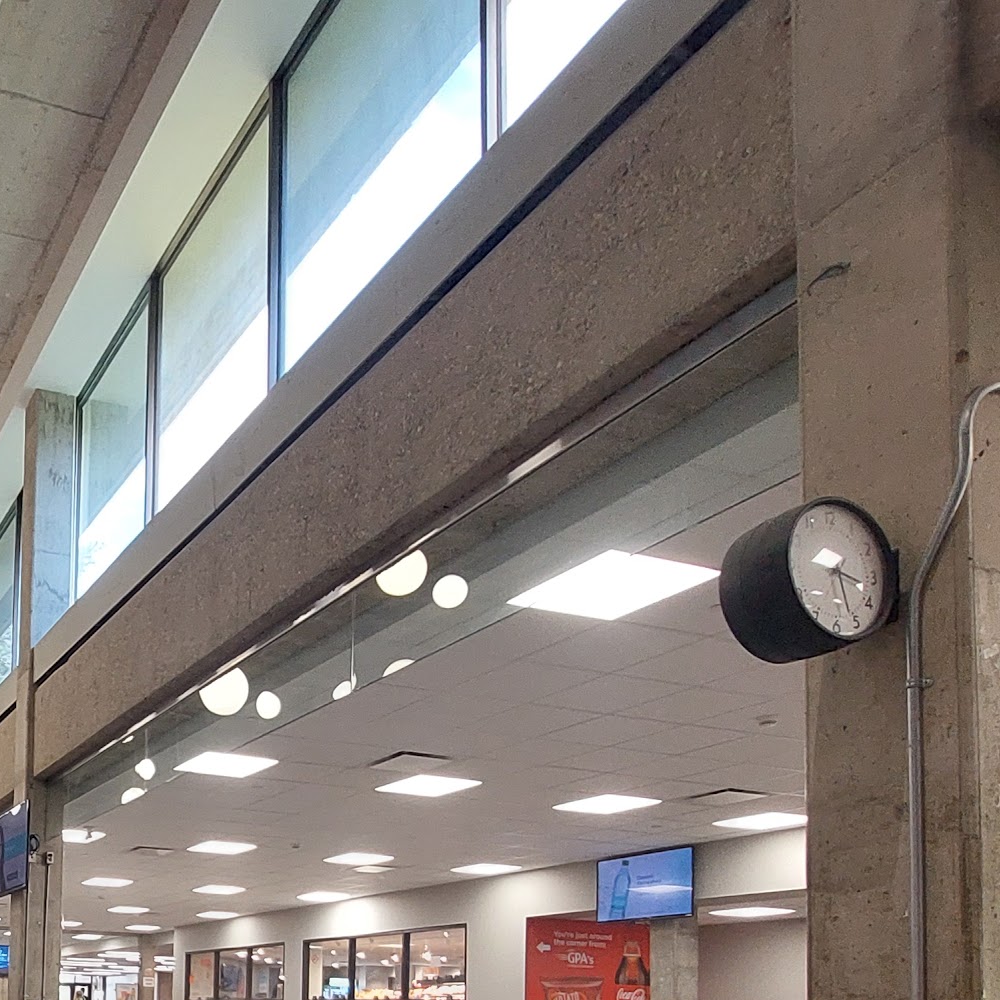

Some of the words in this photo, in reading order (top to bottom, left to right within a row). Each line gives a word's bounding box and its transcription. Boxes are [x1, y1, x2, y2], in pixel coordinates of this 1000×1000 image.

[863, 544, 872, 557] 2
[869, 571, 877, 586] 3
[864, 595, 874, 610] 4
[832, 619, 842, 634] 6
[852, 615, 861, 630] 5
[553, 938, 566, 946] the
[567, 951, 595, 965] GPA's
